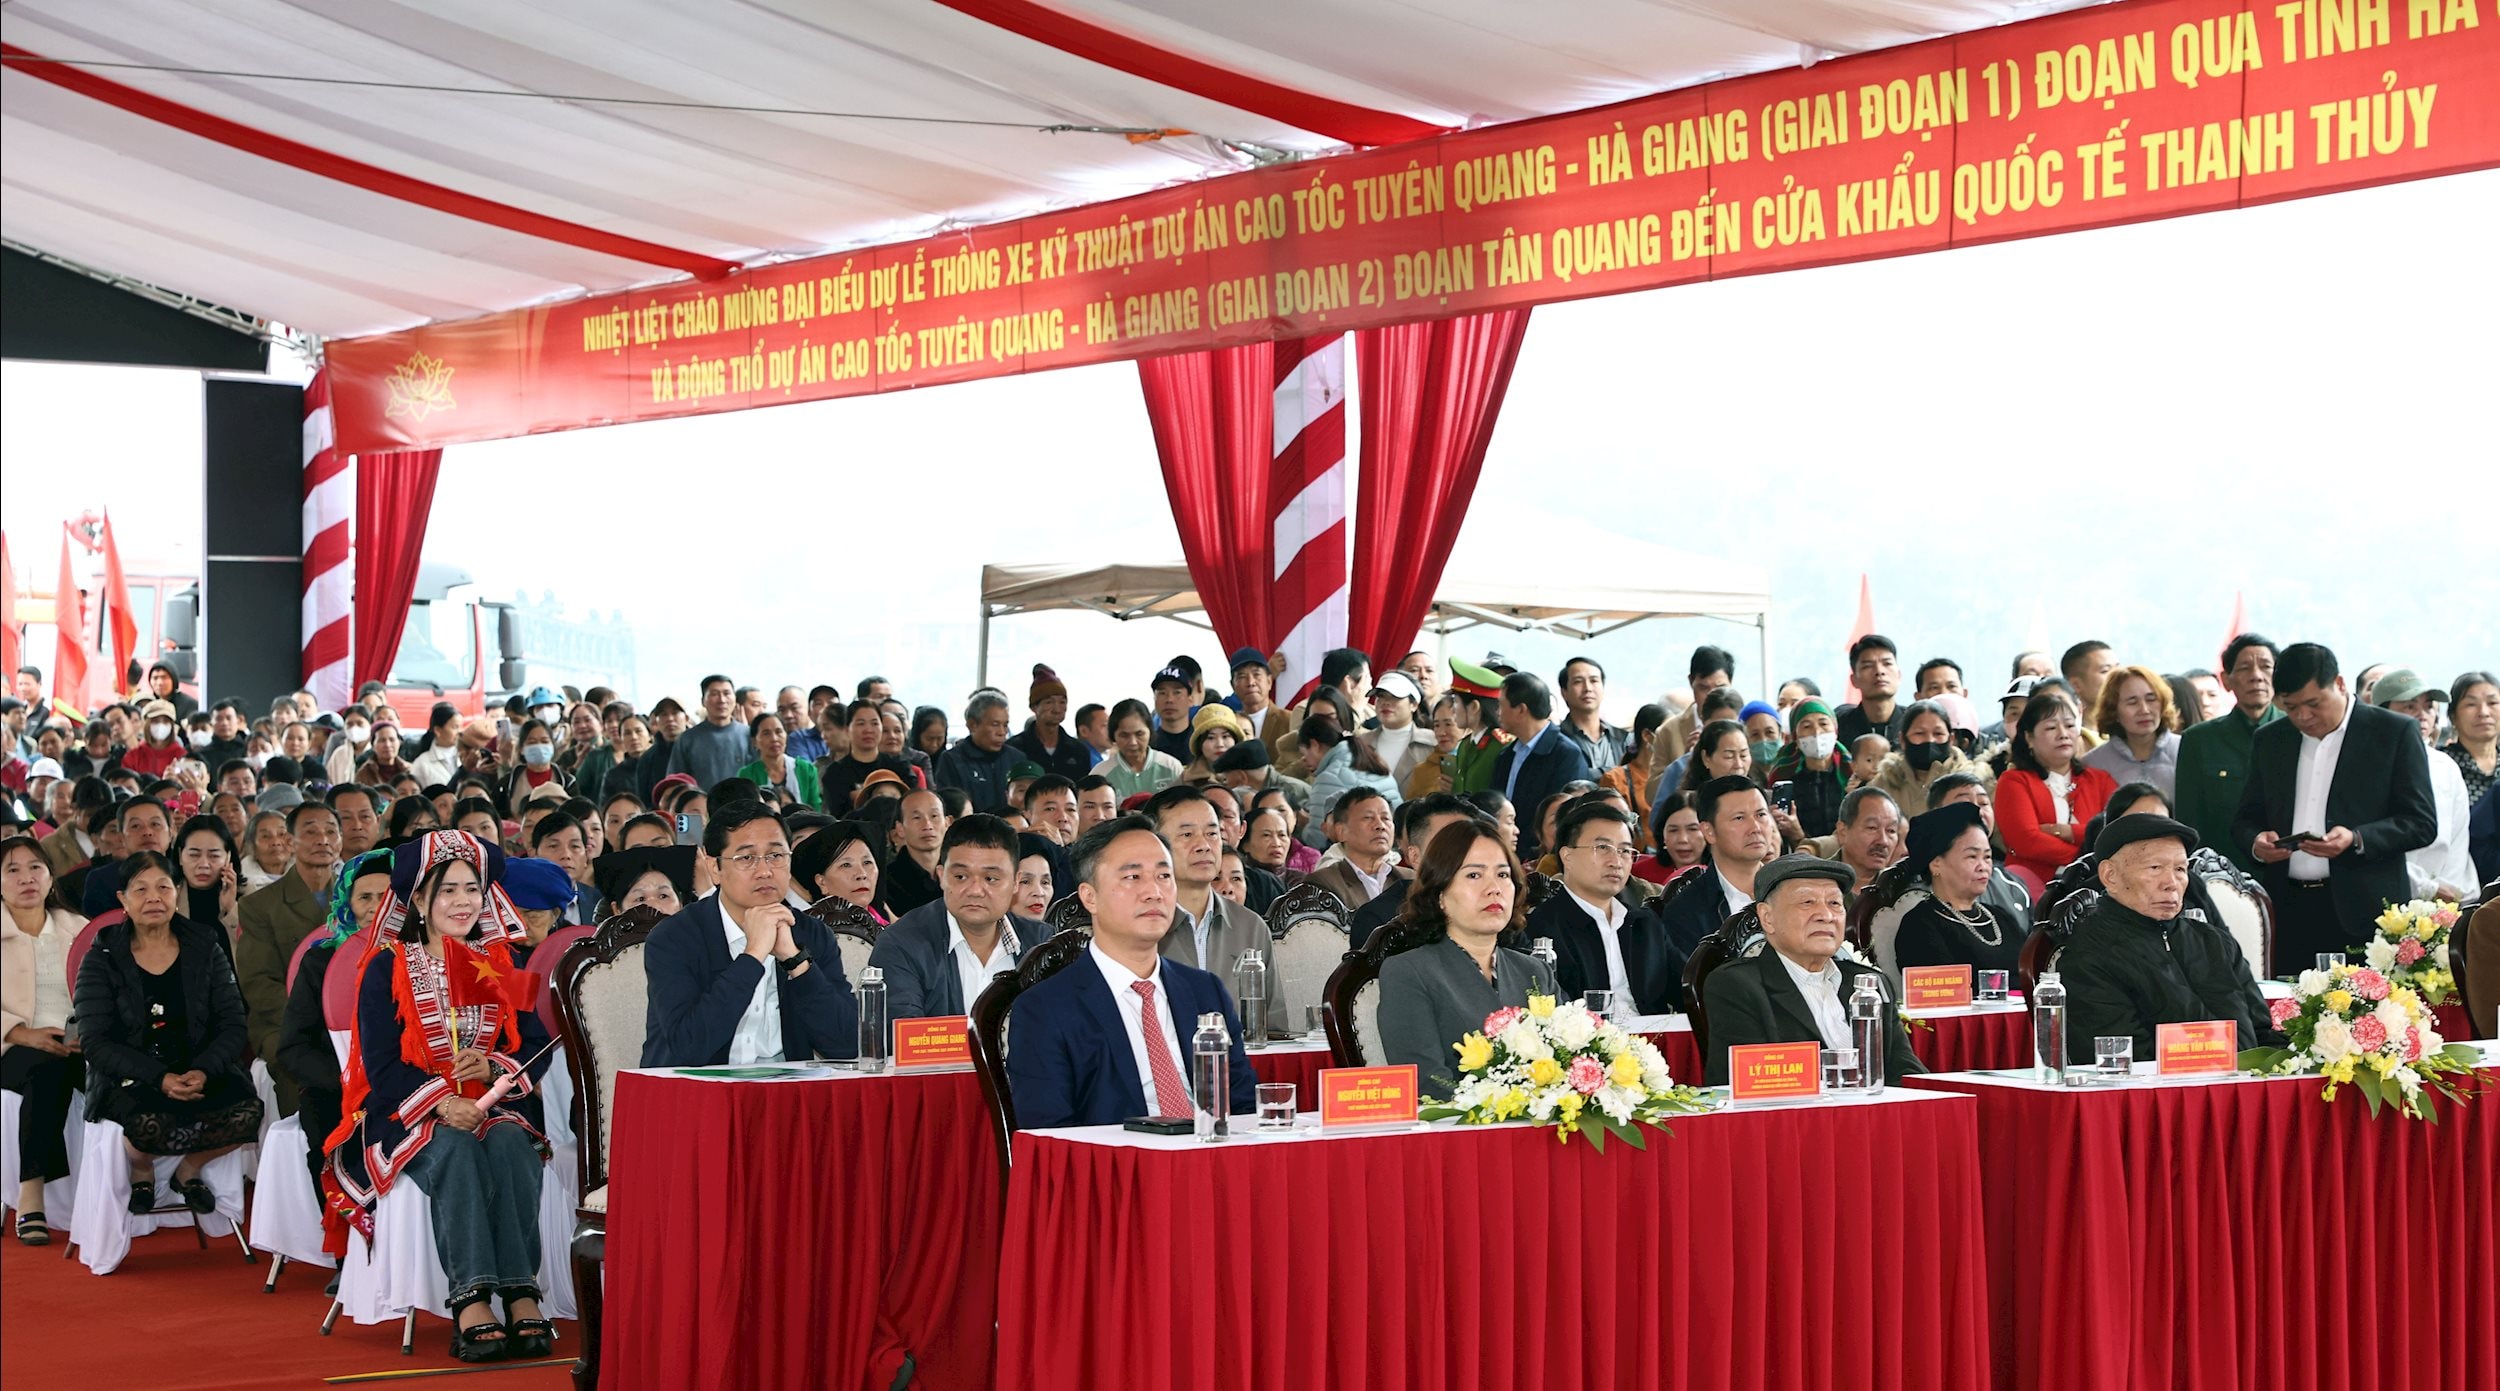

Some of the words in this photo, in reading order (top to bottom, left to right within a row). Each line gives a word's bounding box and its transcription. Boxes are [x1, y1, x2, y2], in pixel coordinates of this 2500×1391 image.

[583, 306, 630, 355] NHIỆT
[634, 303, 669, 348] LIỆT
[672, 292, 719, 338] CHÀO
[723, 284, 780, 331] MỪNG
[782, 280, 815, 328] ĐẠI
[820, 258, 865, 317] BIỂU
[870, 262, 899, 314] DỰ
[903, 249, 926, 303] LỄ
[930, 245, 1002, 298] THÔNG
[1005, 241, 1035, 286] XE
[1040, 228, 1069, 280] KỸ
[1073, 215, 1147, 276] THUẬT
[1151, 208, 1187, 266] DỰ
[1192, 199, 1229, 253] ÁN
[1235, 194, 1286, 244] CAO
[1292, 169, 1345, 234] TỐC
[1353, 161, 1444, 224] TUYÊN
[1454, 145, 1557, 213] QUANG
[1587, 121, 1634, 187] HÀ
[1641, 108, 1750, 177] GIANG
[1761, 90, 1849, 161] (GIAI
[1859, 67, 1969, 142] ĐOẠN
[1982, 59, 2021, 121] 1)
[2034, 31, 2157, 110] ĐOẠN
[2170, 10, 2264, 89] QUA
[651, 360, 676, 404] VÀ
[676, 357, 726, 407] ĐỘNG
[730, 339, 766, 393] THỔ
[768, 347, 797, 395] DỰ
[798, 339, 827, 386] ÁN
[831, 340, 869, 382] CAO
[876, 321, 912, 375] TỐC
[917, 315, 985, 369] TUYÊN
[990, 308, 1065, 363] QUANG
[1087, 291, 1119, 345] HÀ
[1123, 288, 1201, 339] GIANG
[1208, 276, 1270, 331] (GIAI
[1274, 263, 1352, 324] ĐOẠN
[1357, 258, 1386, 309] 2)
[1393, 244, 1475, 306] ĐOẠN
[1482, 226, 1544, 292] TÂN
[1552, 214, 1662, 284] QUANG
[1670, 187, 1742, 262] ĐẾN
[1752, 174, 1826, 250] CỬA
[1836, 150, 1941, 239] KHẨU
[1953, 132, 2064, 225] QUỐC
[2076, 118, 2130, 201] TẾ
[2140, 109, 2295, 192] THANH
[2309, 70, 2438, 165] THỦY
[1748, 1062, 1762, 1077] LÝ
[1764, 1063, 1780, 1077] THỊ
[1783, 1062, 1804, 1075] LAN
